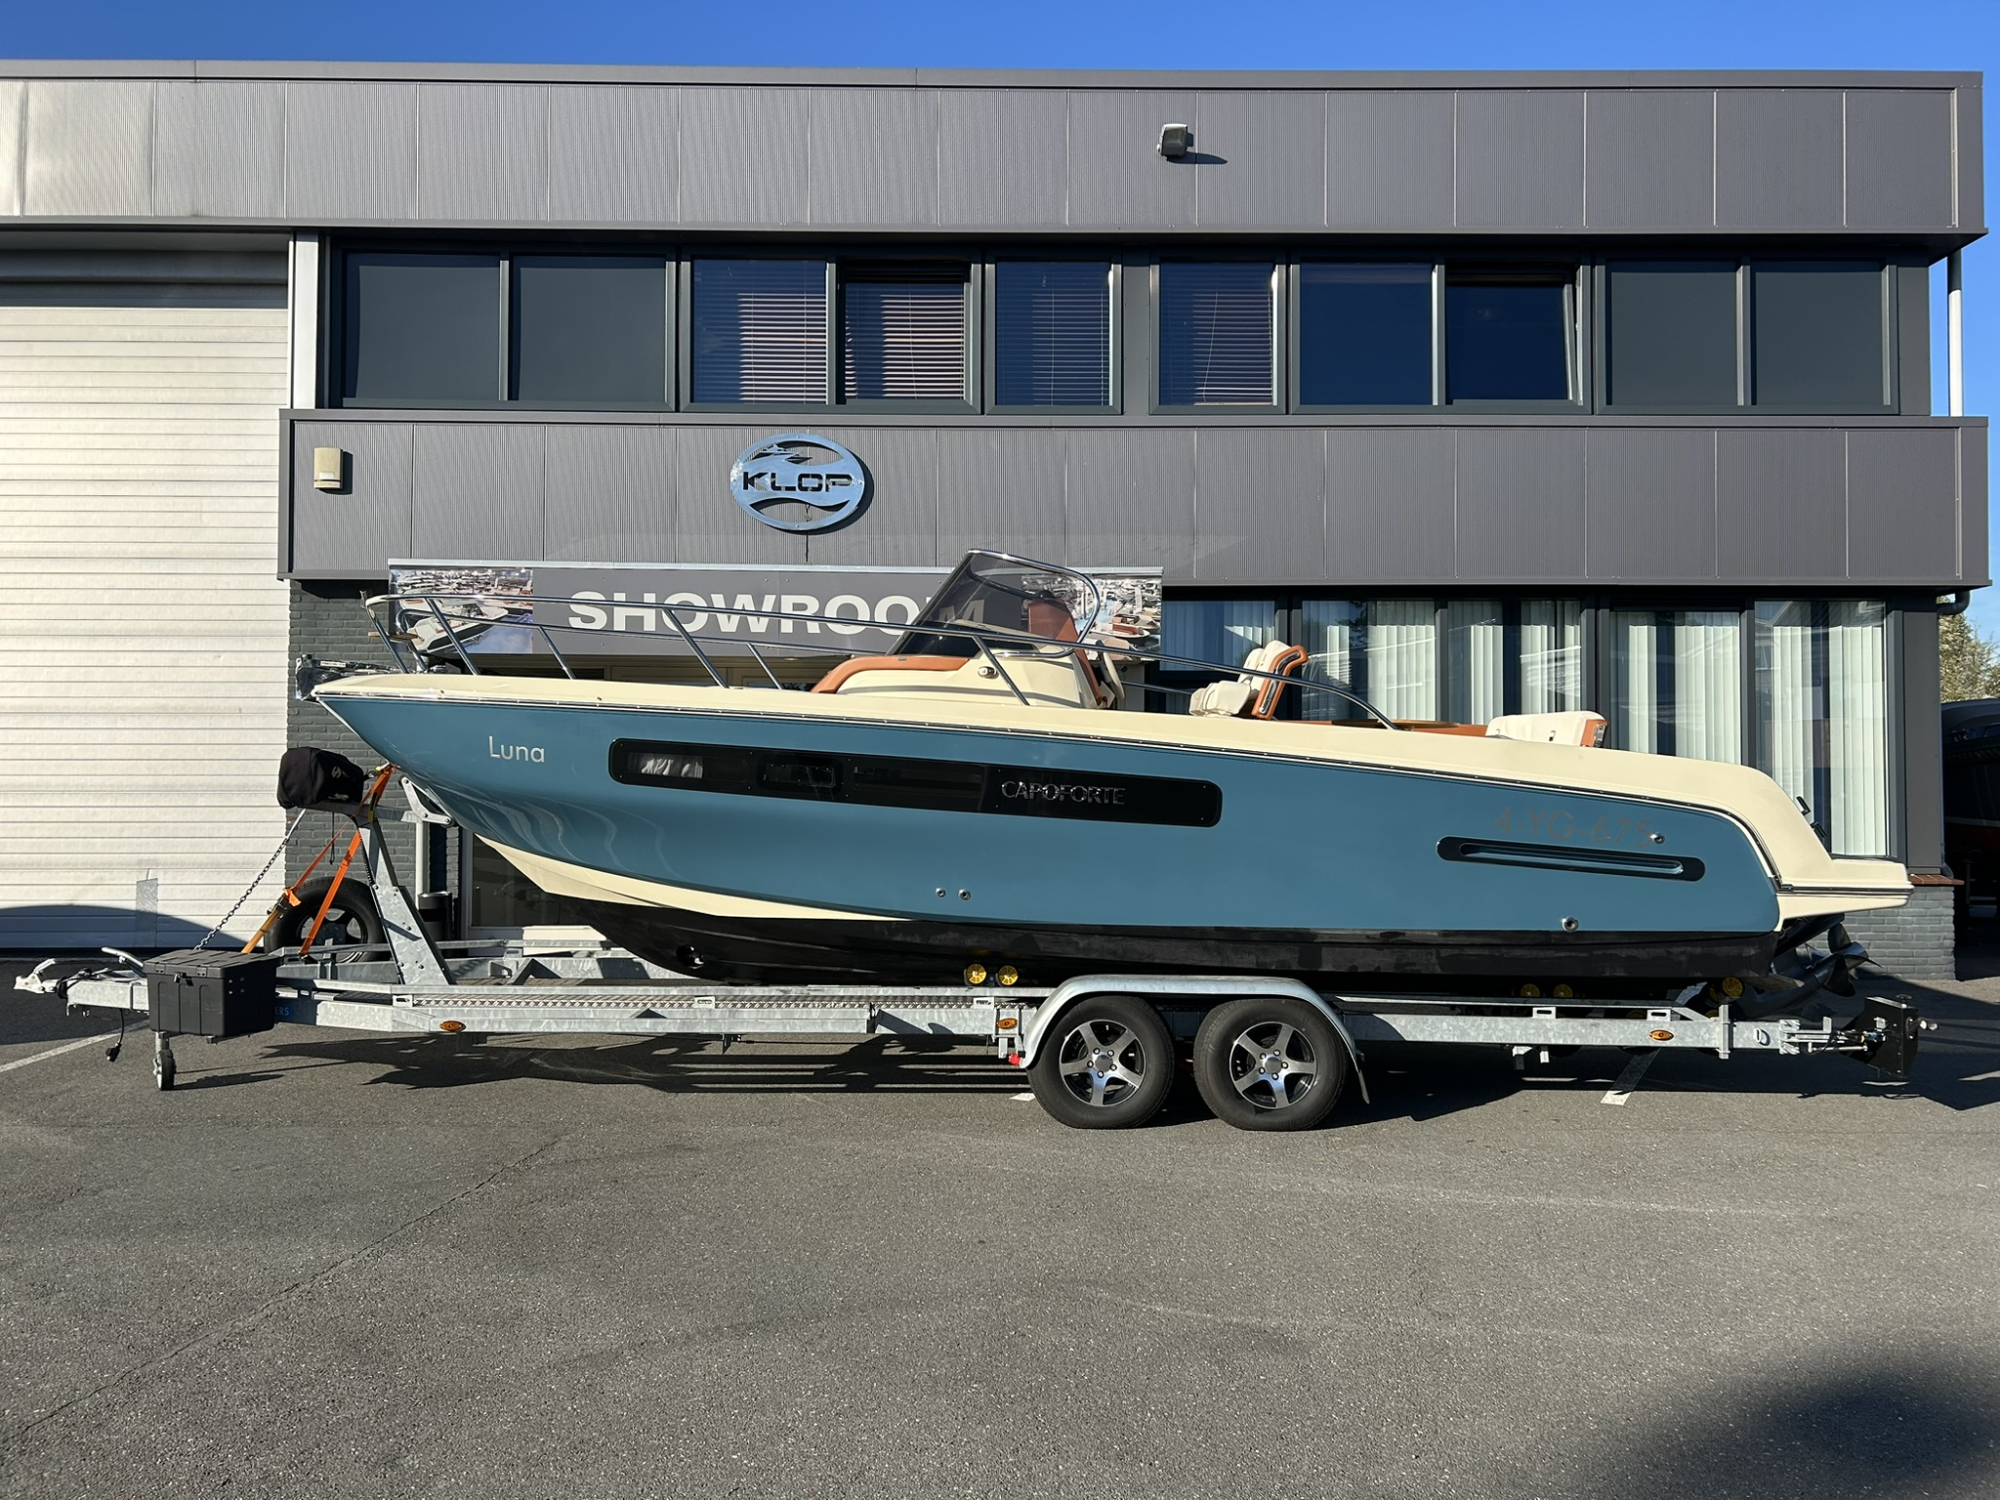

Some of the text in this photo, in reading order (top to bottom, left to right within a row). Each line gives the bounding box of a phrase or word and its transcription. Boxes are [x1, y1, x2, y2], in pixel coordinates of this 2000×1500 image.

[743, 471, 853, 492] KLOP
[488, 735, 545, 763] Luna
[1001, 780, 1126, 805] CAPOFORTE
[1494, 806, 1653, 848] 4-YG-675
